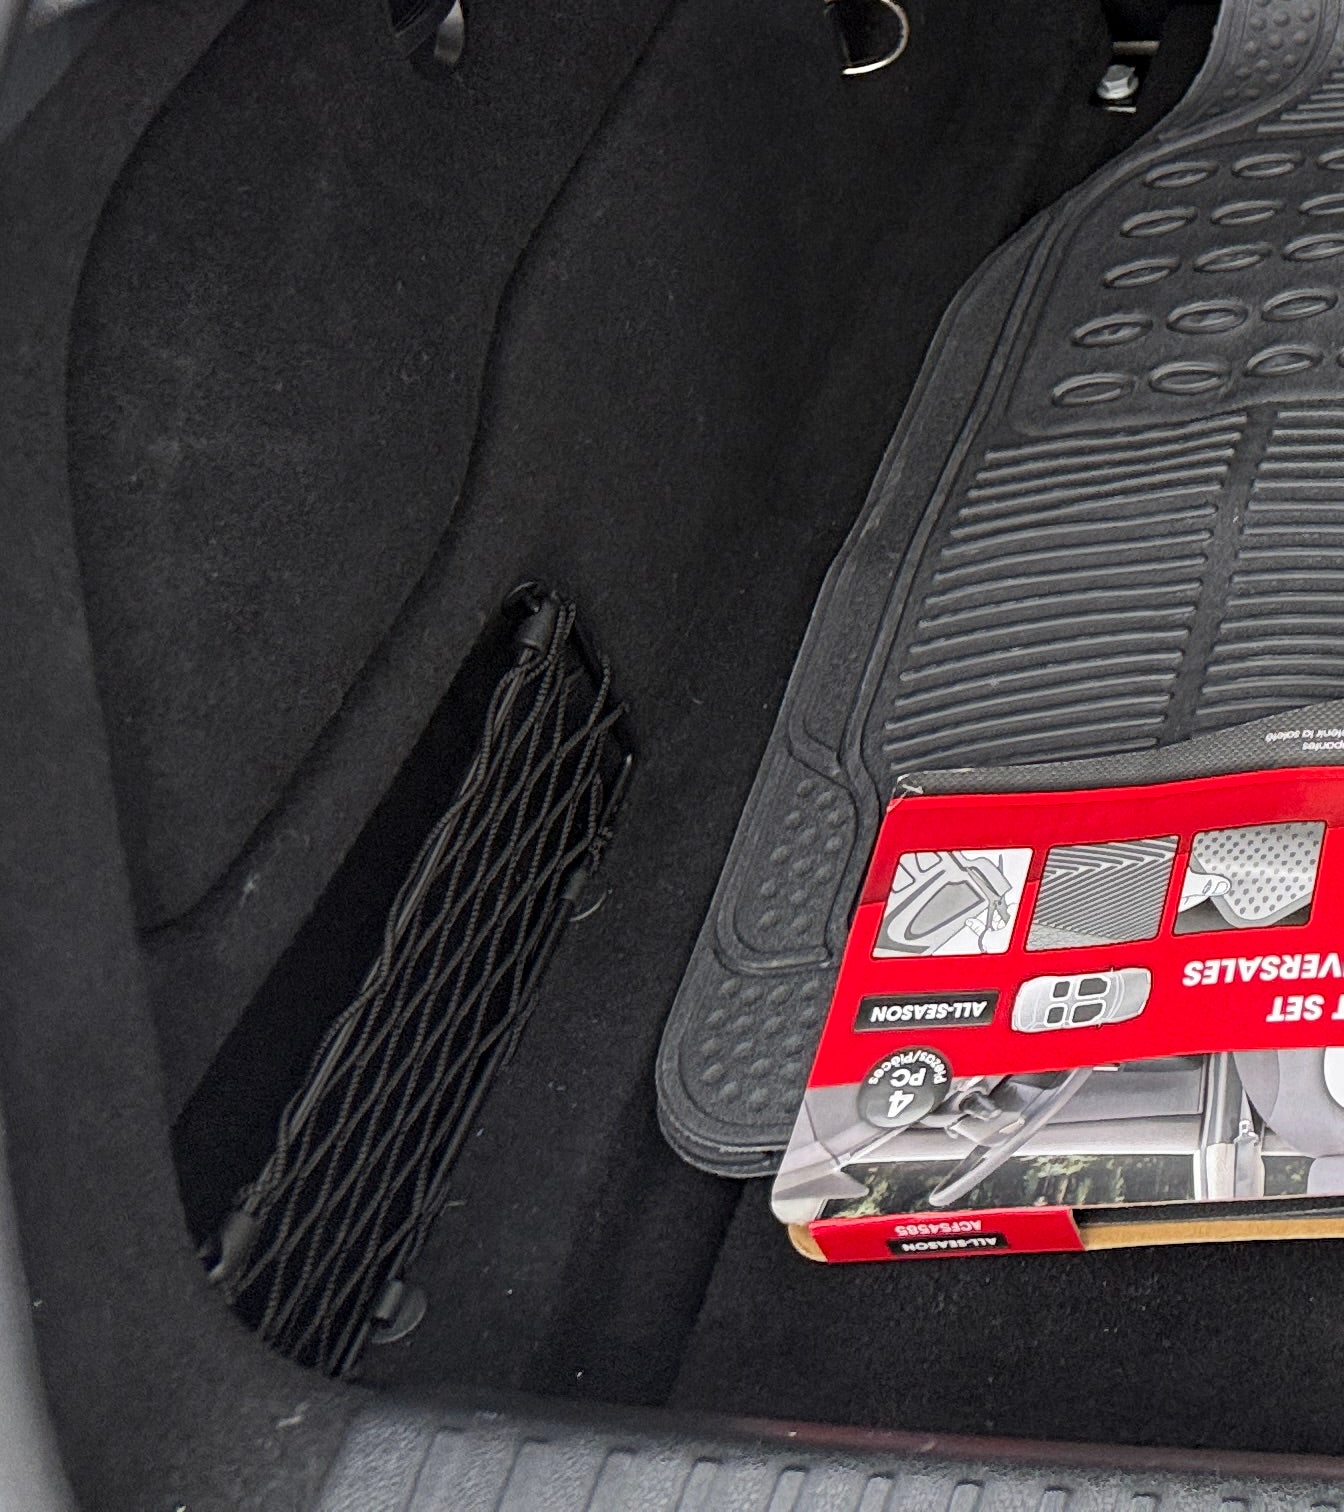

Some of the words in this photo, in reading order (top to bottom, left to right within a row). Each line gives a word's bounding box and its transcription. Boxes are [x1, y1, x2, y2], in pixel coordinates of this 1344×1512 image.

[870, 1000, 988, 1023] ALL-SEASON
[1265, 994, 1325, 1023] SET
[890, 1067, 927, 1088] PC
[887, 1090, 915, 1118] 4
[894, 1219, 982, 1237] ACFS4585
[901, 1237, 997, 1252] ALL-SEASON
